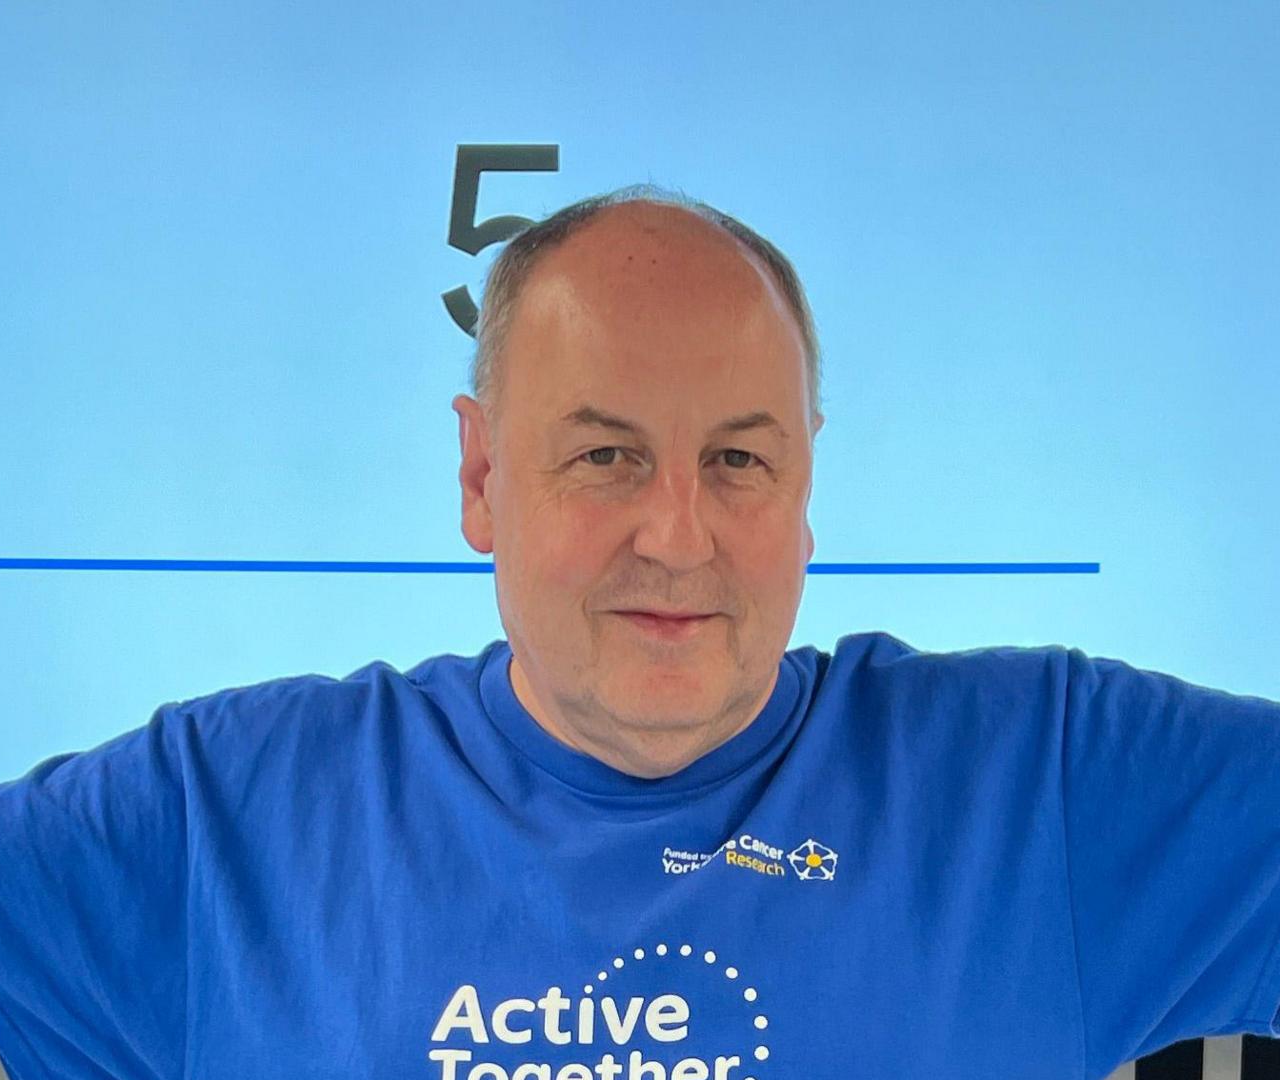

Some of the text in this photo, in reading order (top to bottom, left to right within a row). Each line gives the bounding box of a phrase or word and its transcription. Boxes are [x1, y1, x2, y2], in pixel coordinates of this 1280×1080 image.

[663, 847, 699, 861] Funded
[739, 835, 784, 861] Cancer
[726, 850, 785, 876] Research
[431, 984, 690, 1044] Active
